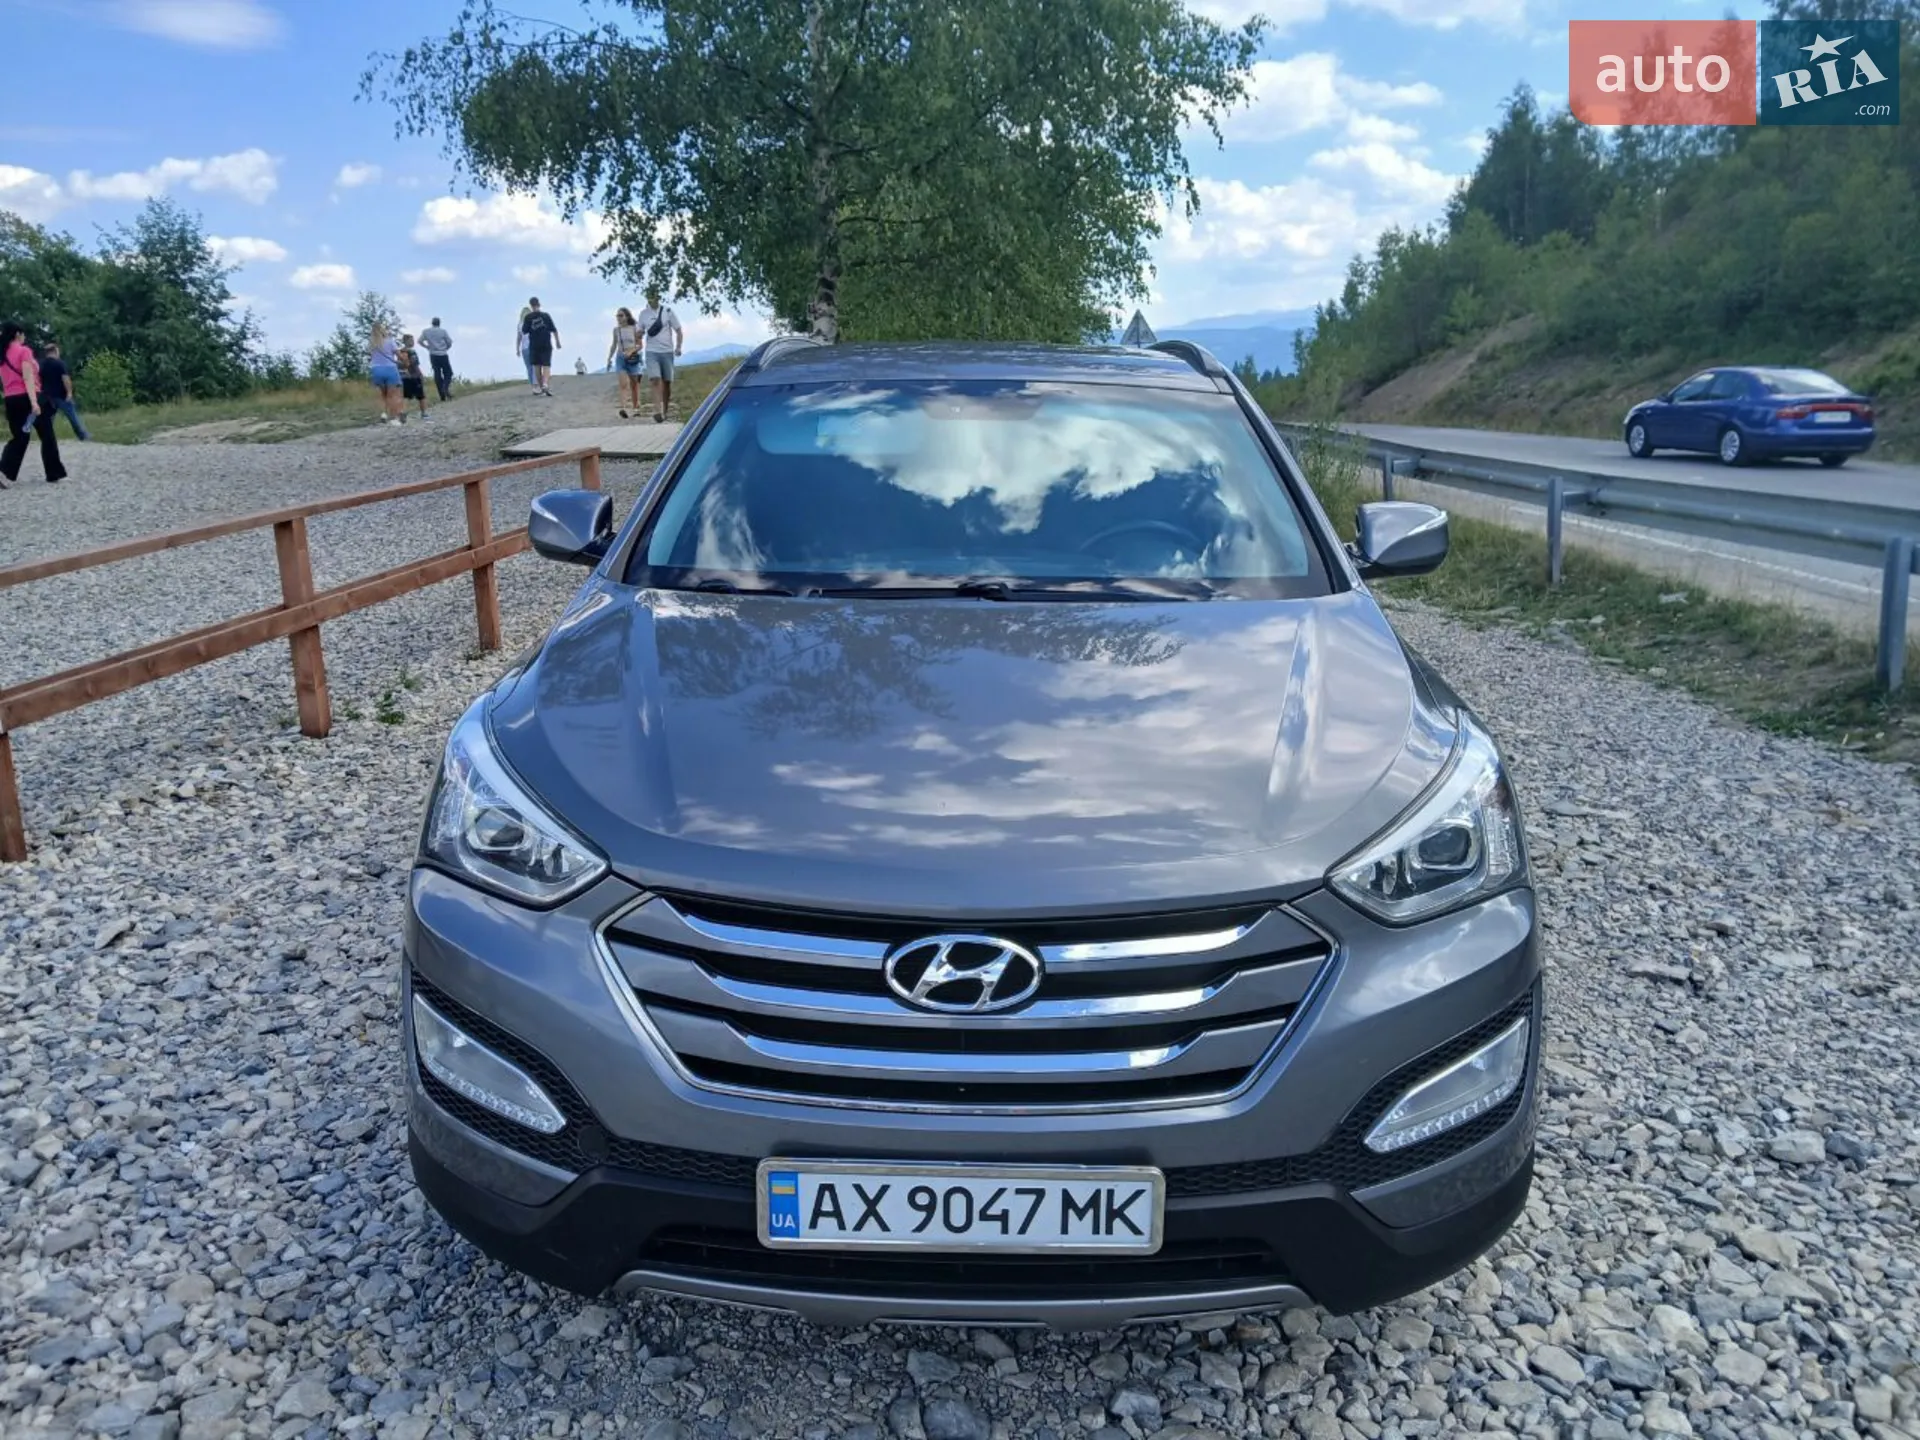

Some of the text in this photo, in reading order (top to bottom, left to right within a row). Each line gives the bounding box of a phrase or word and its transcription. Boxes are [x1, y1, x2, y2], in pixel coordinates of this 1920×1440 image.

[772, 1214, 796, 1229] UA
[808, 1183, 1147, 1236] AX 9047 MK
